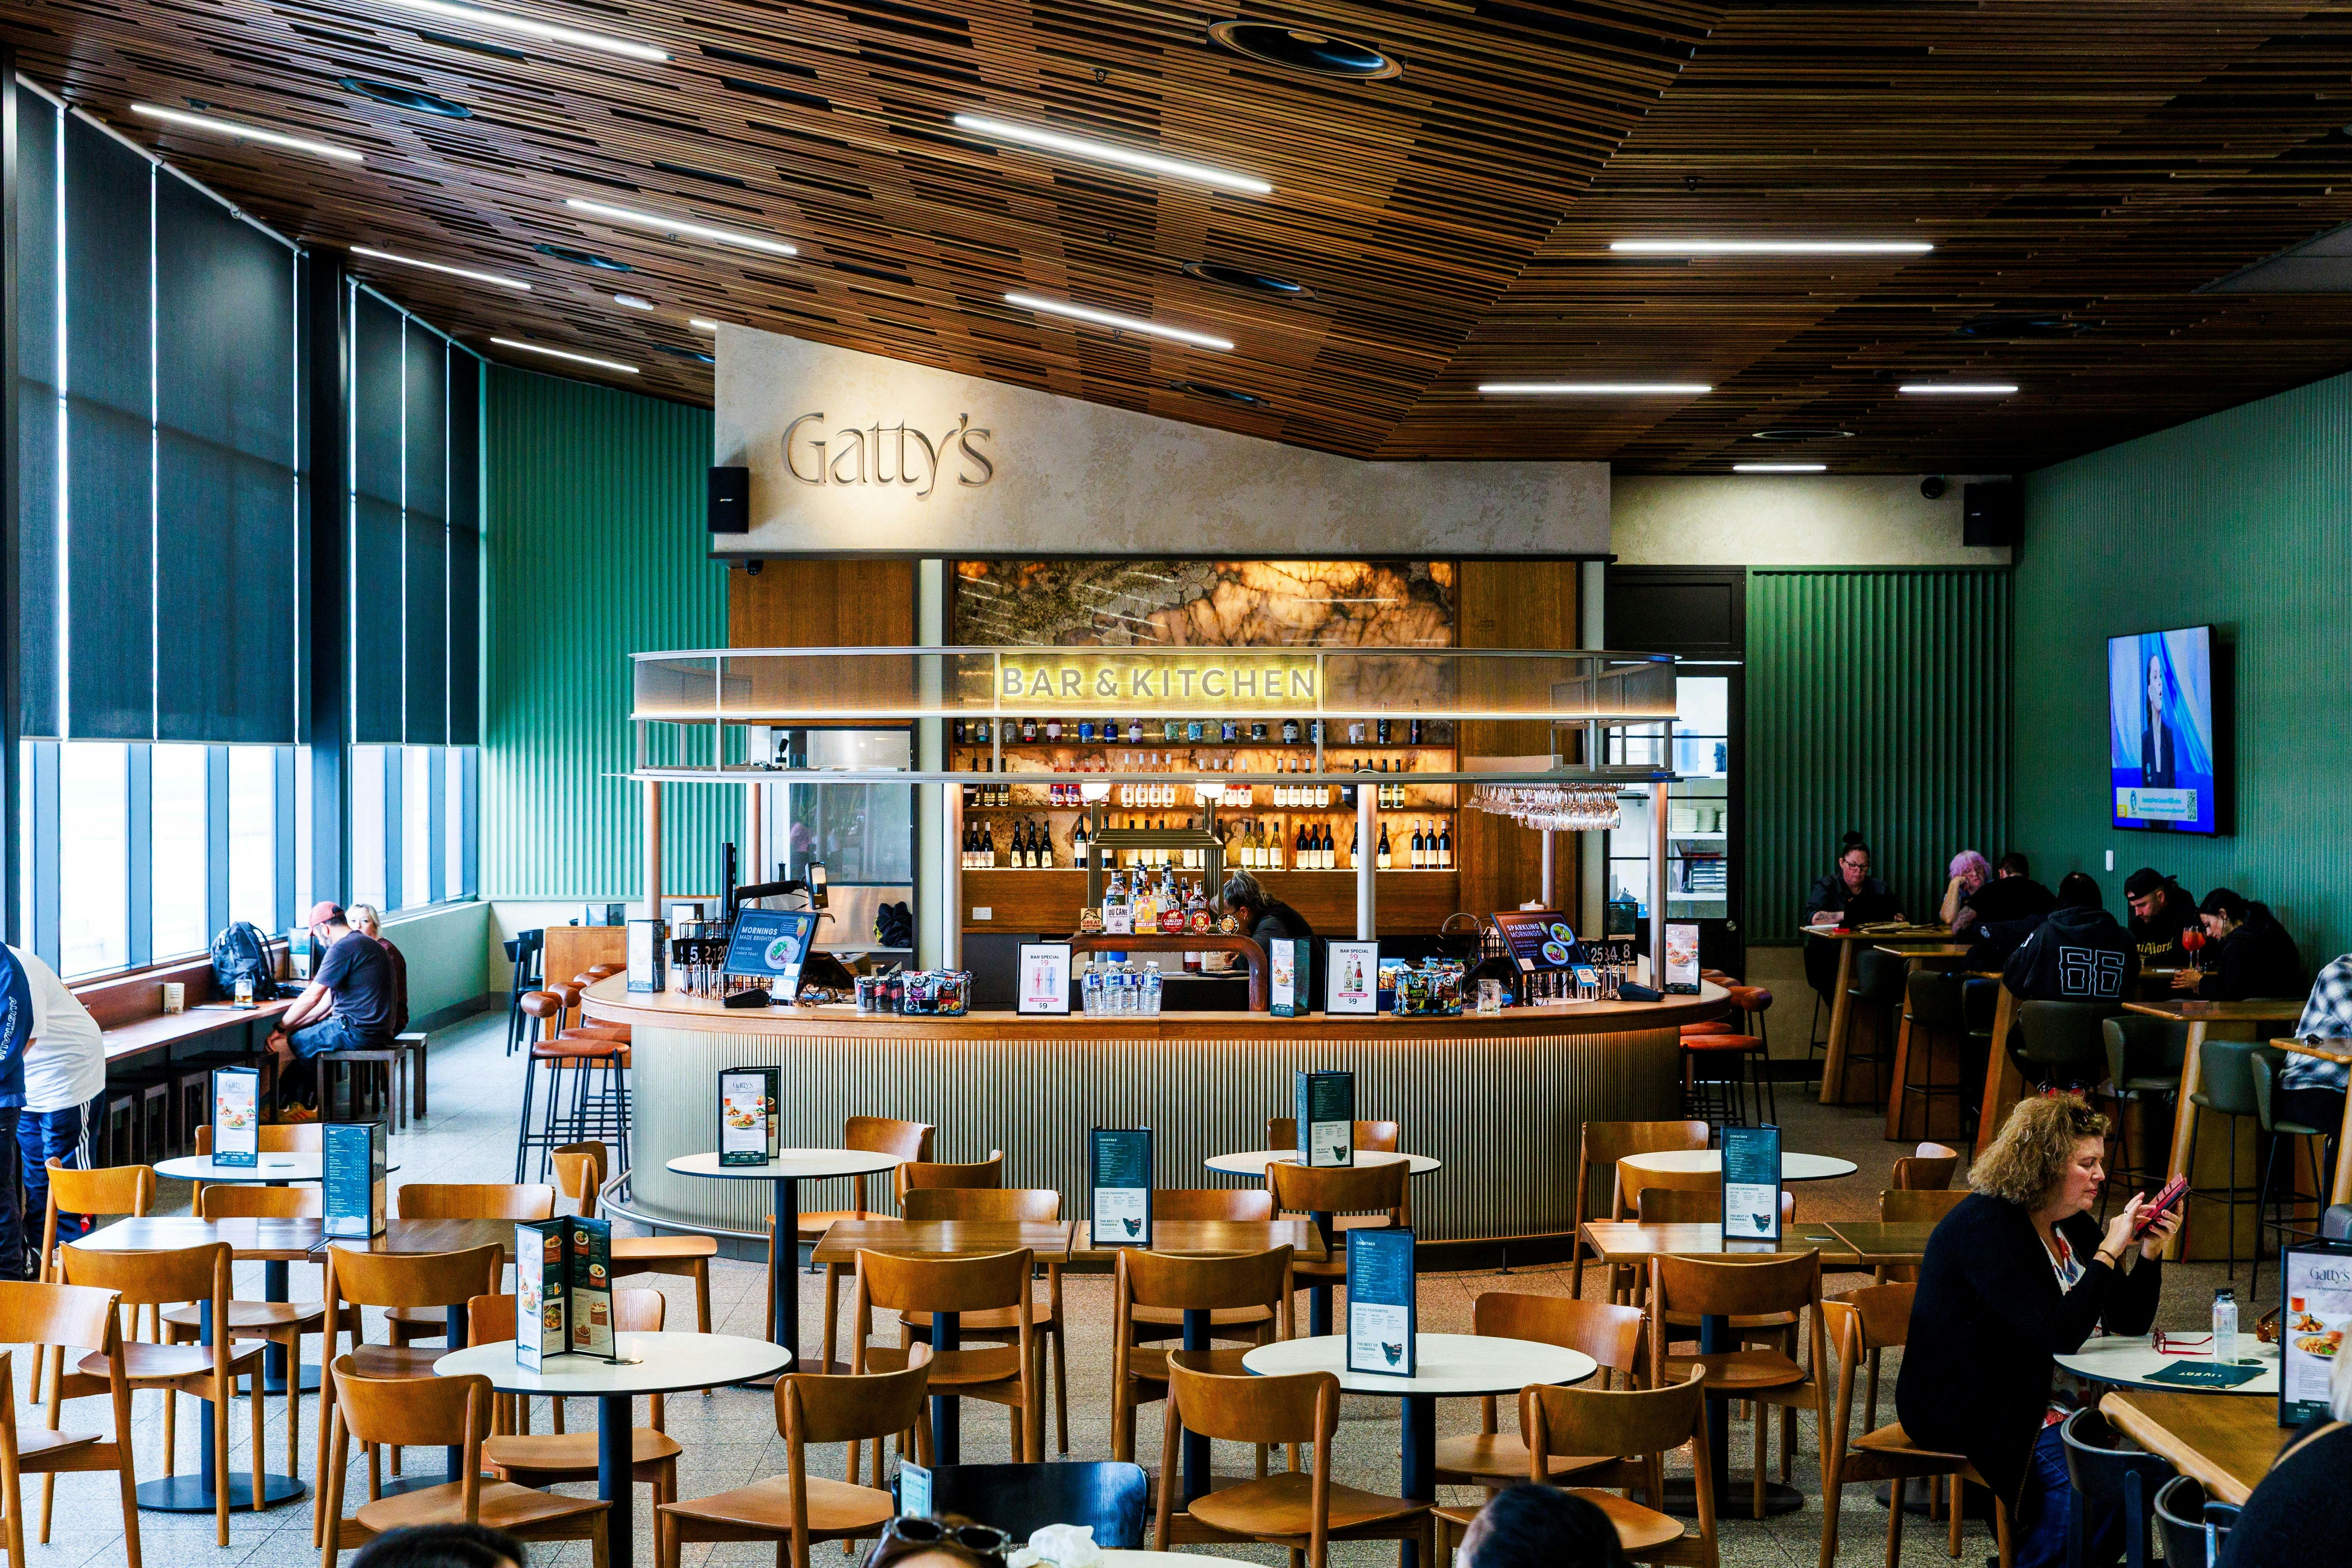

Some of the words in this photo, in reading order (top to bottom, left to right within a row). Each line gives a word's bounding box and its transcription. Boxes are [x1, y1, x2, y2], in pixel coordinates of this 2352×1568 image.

[781, 412, 993, 502] Gatty's
[1002, 668, 1082, 697] BAR
[1096, 668, 1118, 697] &
[1132, 668, 1315, 697] KITCHEN
[741, 926, 778, 935] MORNINGS
[690, 946, 698, 961] 5
[1591, 947, 1603, 962] 25
[1623, 944, 1630, 958] 8
[2059, 946, 2125, 997] 66
[733, 1081, 753, 1089] Gatty's
[2310, 1266, 2350, 1284] Gatty's
